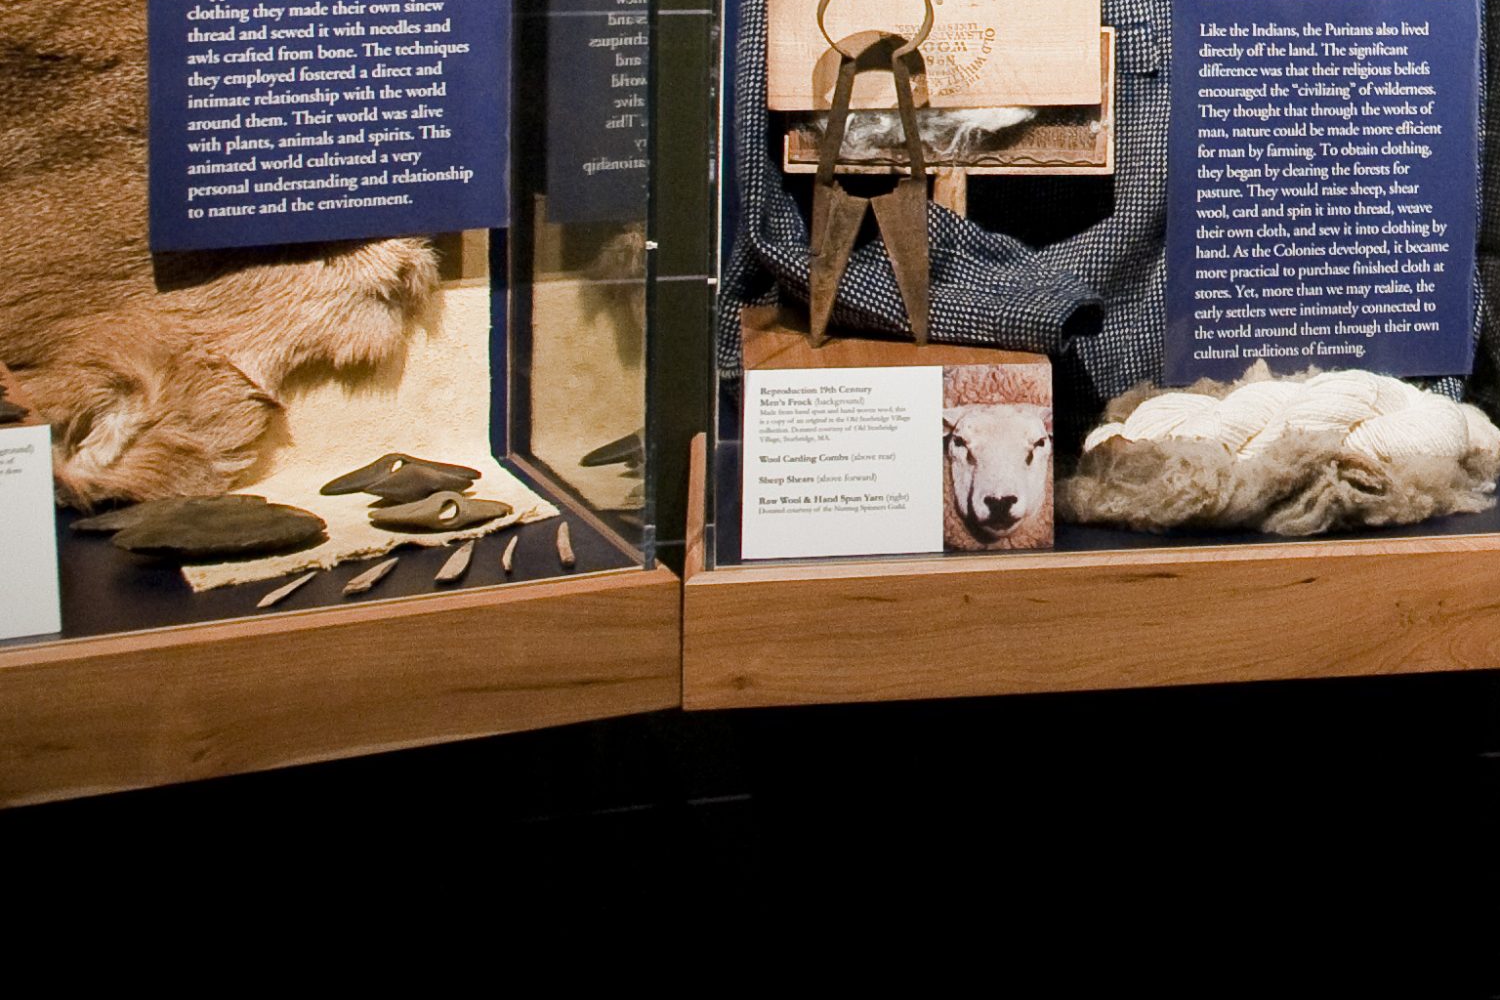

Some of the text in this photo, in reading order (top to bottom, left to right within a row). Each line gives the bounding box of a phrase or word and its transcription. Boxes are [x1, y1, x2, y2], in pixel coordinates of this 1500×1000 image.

[1199, 21, 1429, 37] Like the Indians, the Puritans also lived
[186, 40, 469, 64] awls crafted from bone. The techniques
[1197, 81, 1436, 101] encouraged the “civilizing” of wilderness.
[187, 166, 473, 199] personal understanding and relationship
[1196, 180, 1419, 202] pasture. They would raise sheep, shear
[1194, 297, 1436, 322] early settlers were intimately connected to
[1193, 340, 1366, 359] cultural traditions of farming.
